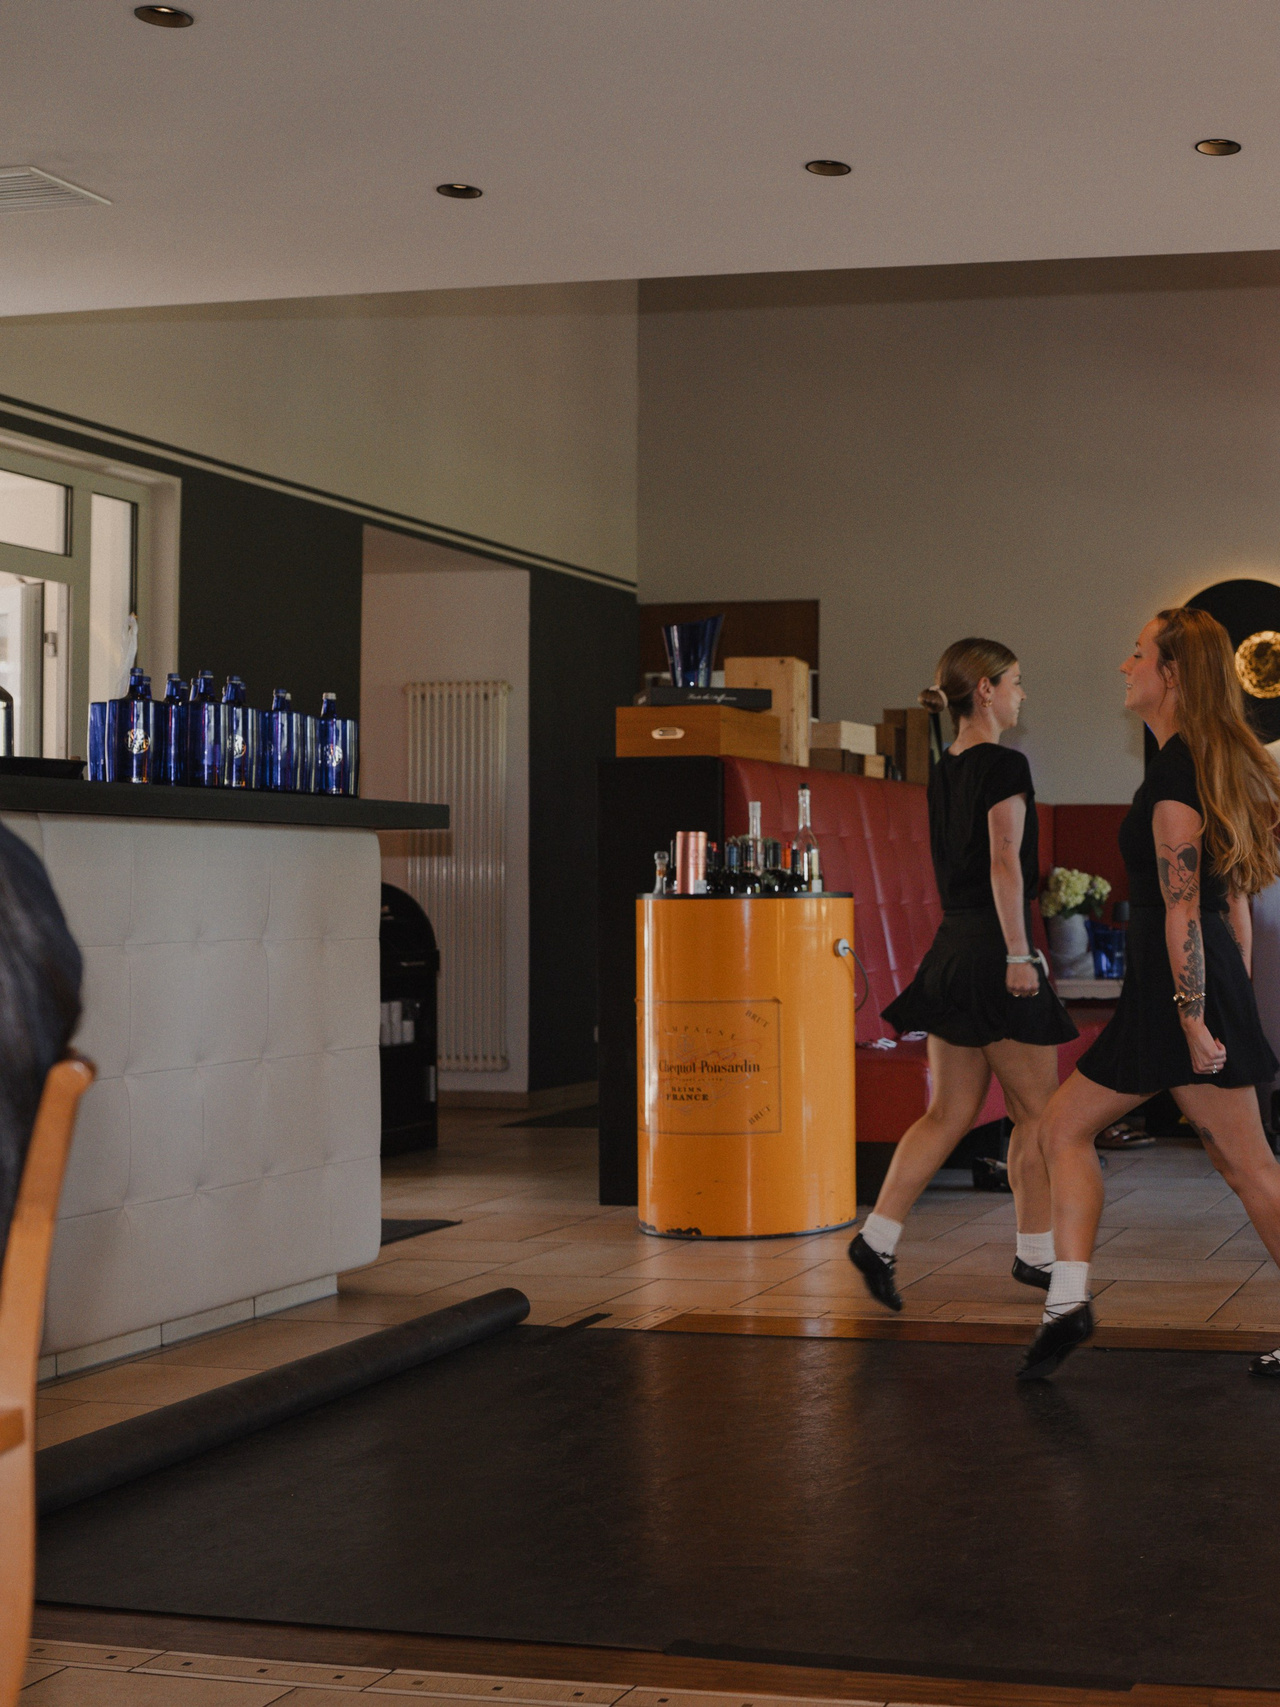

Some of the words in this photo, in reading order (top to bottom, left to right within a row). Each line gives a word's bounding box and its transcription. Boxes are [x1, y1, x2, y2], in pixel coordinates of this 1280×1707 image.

[745, 1009, 769, 1028] BRUT
[700, 1059, 760, 1074] Ponsardin
[666, 1093, 709, 1102] FRANCE
